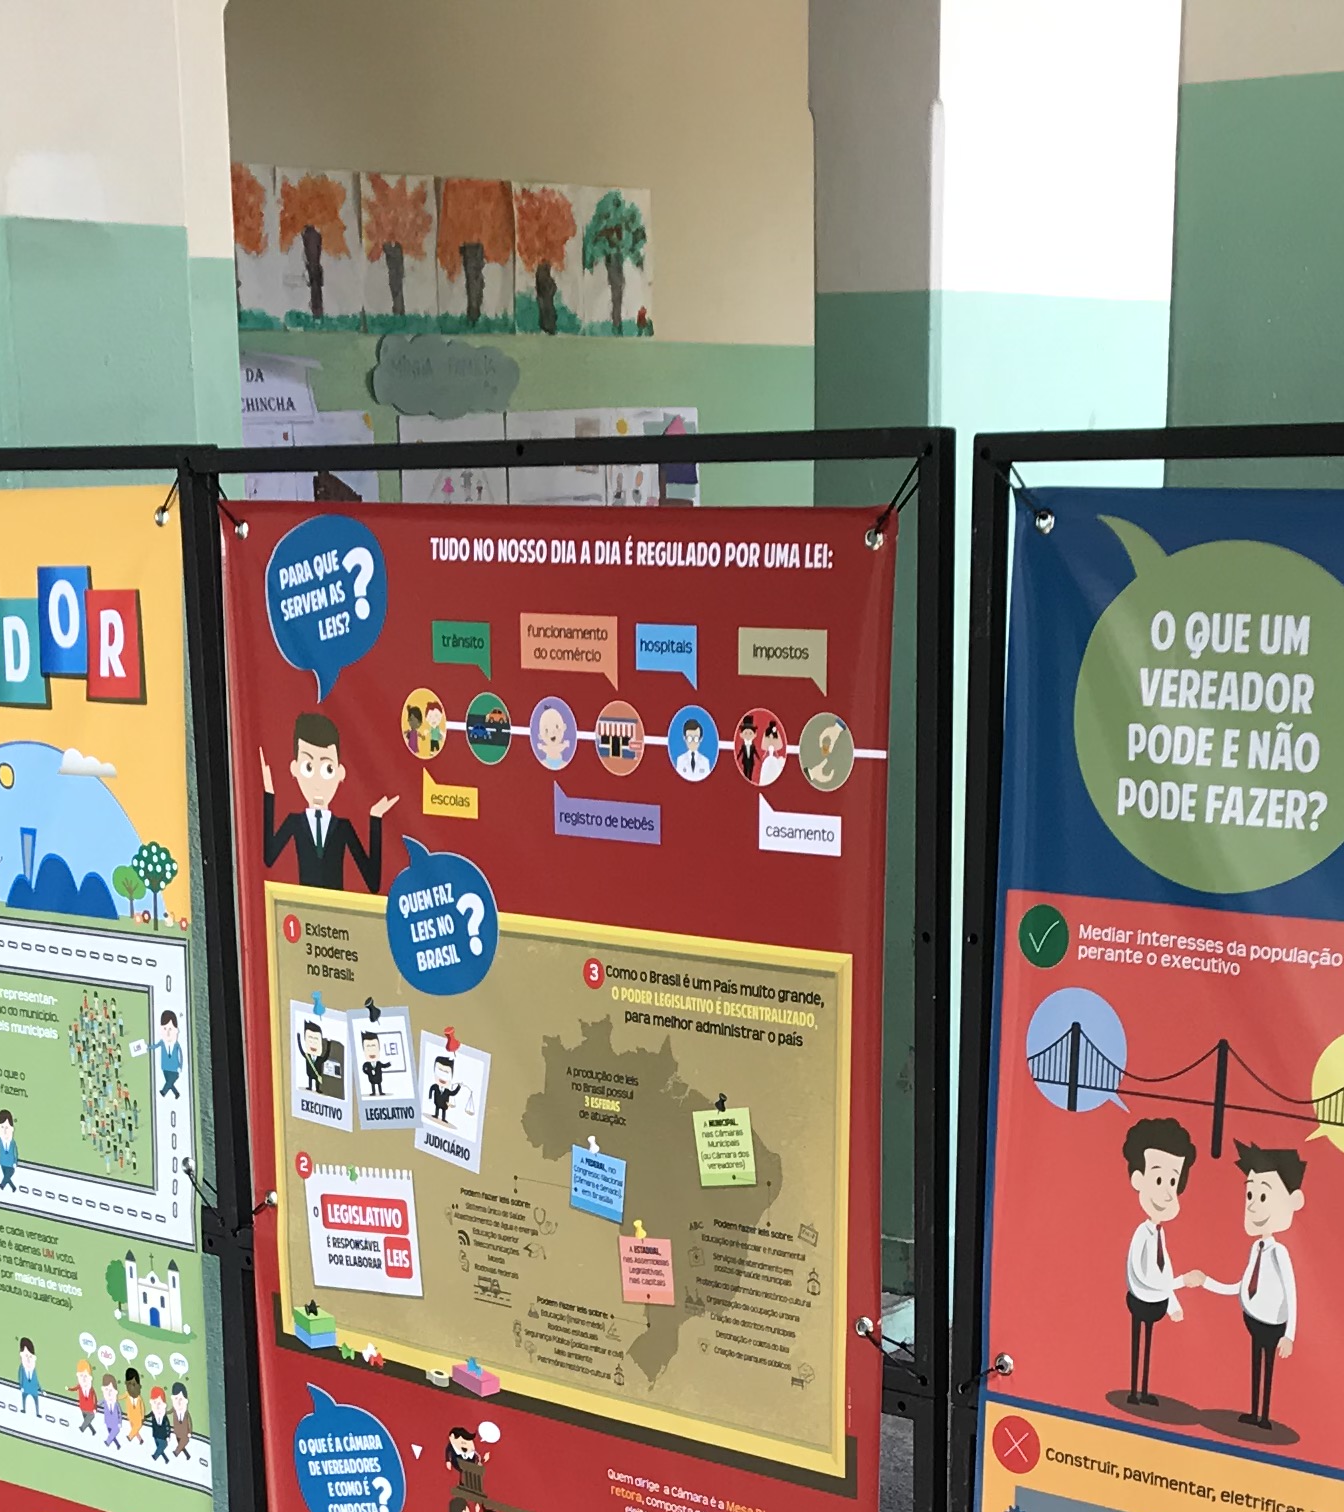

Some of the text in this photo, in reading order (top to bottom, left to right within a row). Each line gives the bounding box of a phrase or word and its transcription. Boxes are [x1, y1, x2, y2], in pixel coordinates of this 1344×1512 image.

[246, 367, 264, 383] DA
[430, 535, 834, 569] TUDO NO NOSSO DIA A DIA É REGULADO POR UMA LEI:
[279, 549, 340, 590] PARA QUE
[280, 580, 346, 621] SERVEM AS
[318, 611, 350, 641] LEIS?
[527, 624, 608, 641] funcionamento
[1151, 610, 1311, 659] O QUE UM
[441, 634, 484, 651] trânsito
[534, 646, 602, 663] do comércio
[640, 638, 693, 655] hospitais
[752, 643, 809, 661] impostos
[1140, 667, 1315, 715] VEREADOR
[1128, 721, 1321, 774] PODE E NÃO
[430, 794, 470, 808] escolas
[1117, 777, 1328, 832] PODE FAZER?
[559, 811, 654, 832] registro de bebês
[765, 825, 835, 842] casamento
[1078, 924, 1343, 969] Mediar interesses da população
[1077, 943, 1241, 976] perante o executivo
[605, 965, 825, 1009] Como o Brasil é um País muito grande,
[611, 986, 818, 1030] O PODER LEGISLATIVO É DESCENTRALIZADO,
[301, 1099, 343, 1121] EXECUTIVO
[365, 1106, 415, 1121] LEGISLATIVO
[424, 1132, 470, 1161] JUDICIÁRIO
[313, 1204, 402, 1229] O LEGISLATIVO
[327, 1235, 381, 1252] É RESPONSÁVEL
[328, 1253, 383, 1270] POR ELABORAR
[386, 1248, 410, 1268] LEIS
[1045, 1446, 1121, 1479] Construir,
[1123, 1464, 1216, 1503] pavimentar,
